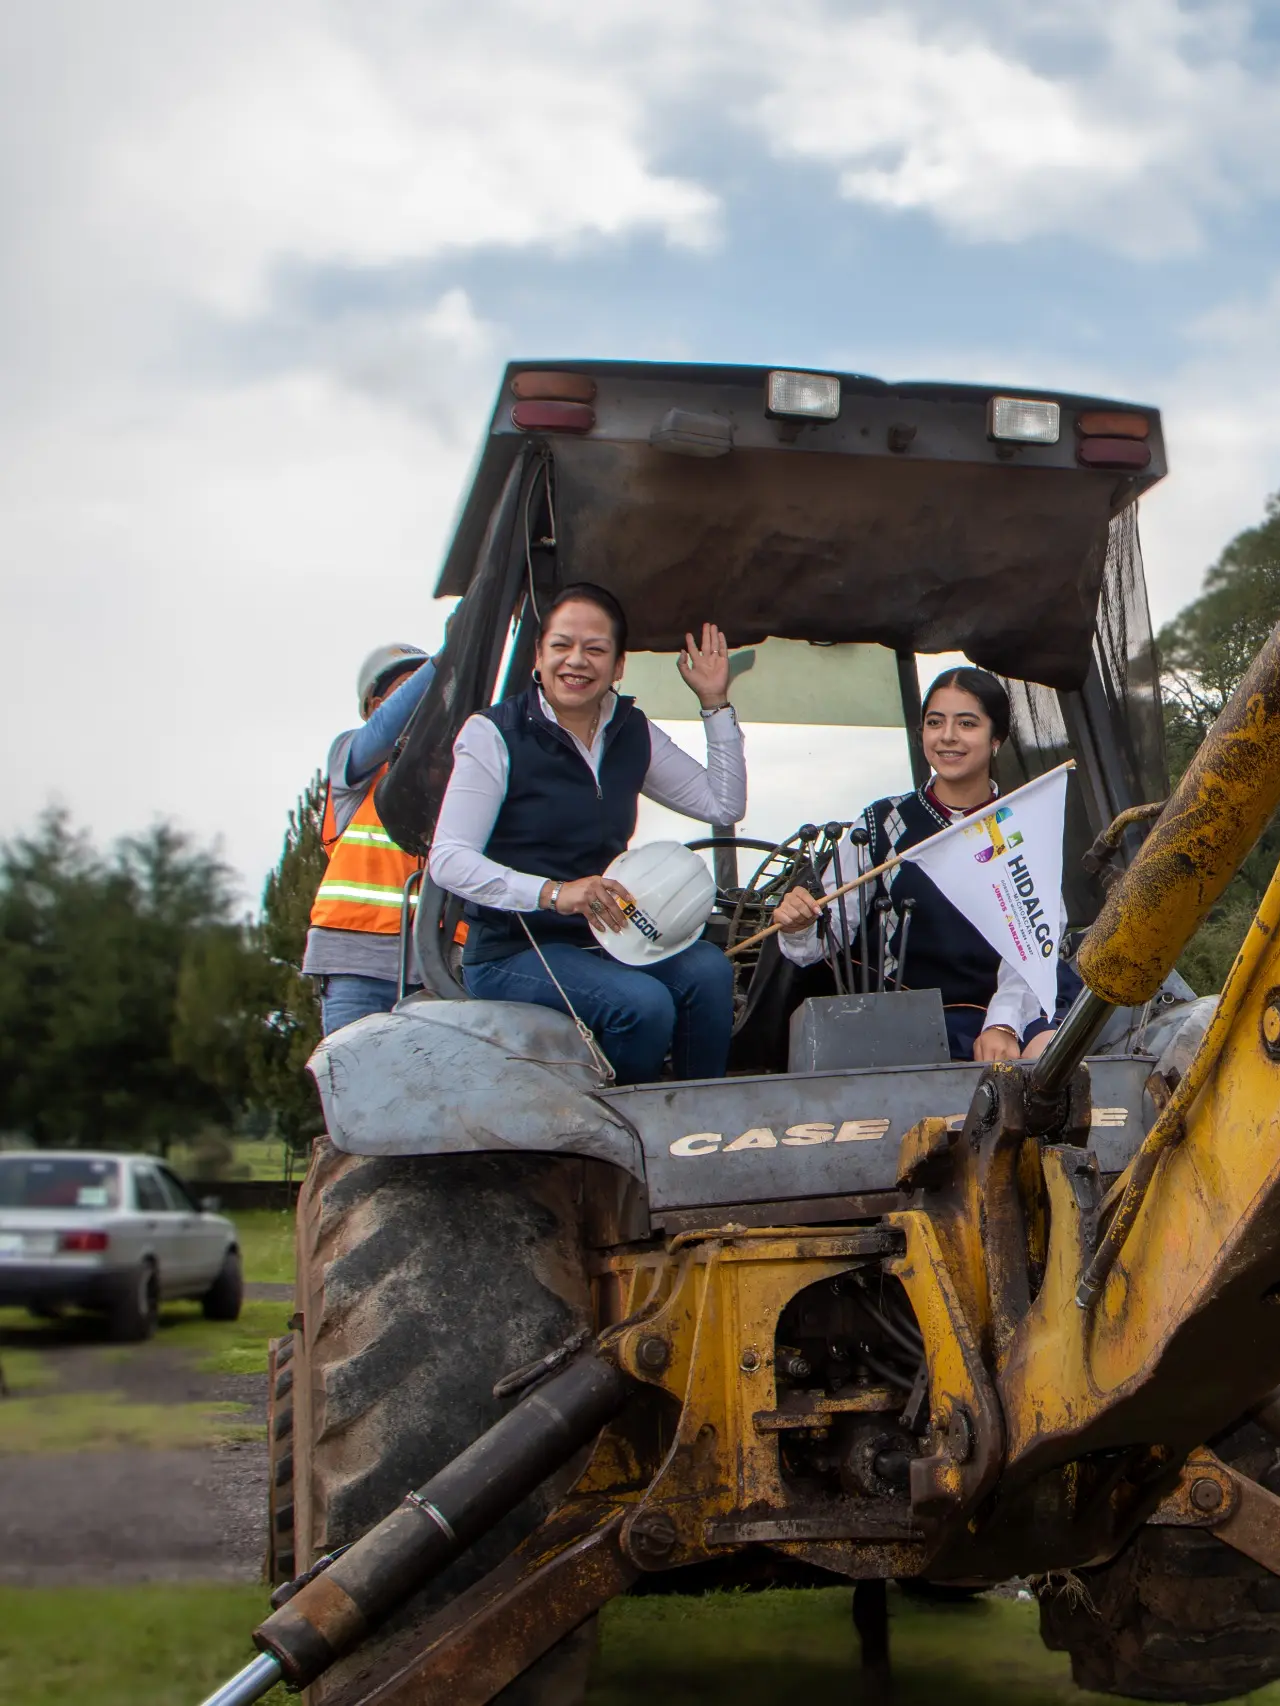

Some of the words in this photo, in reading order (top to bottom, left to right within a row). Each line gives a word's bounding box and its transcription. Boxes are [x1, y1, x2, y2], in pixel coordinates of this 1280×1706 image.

[623, 903, 663, 942] BECON
[992, 883, 1008, 912] JUNTOS
[1005, 914, 1027, 961] AVANZAMOS
[1008, 854, 1054, 958] HIDALGO
[1013, 893, 1032, 935] MICHOACÁN
[670, 1119, 891, 1156] CASE
